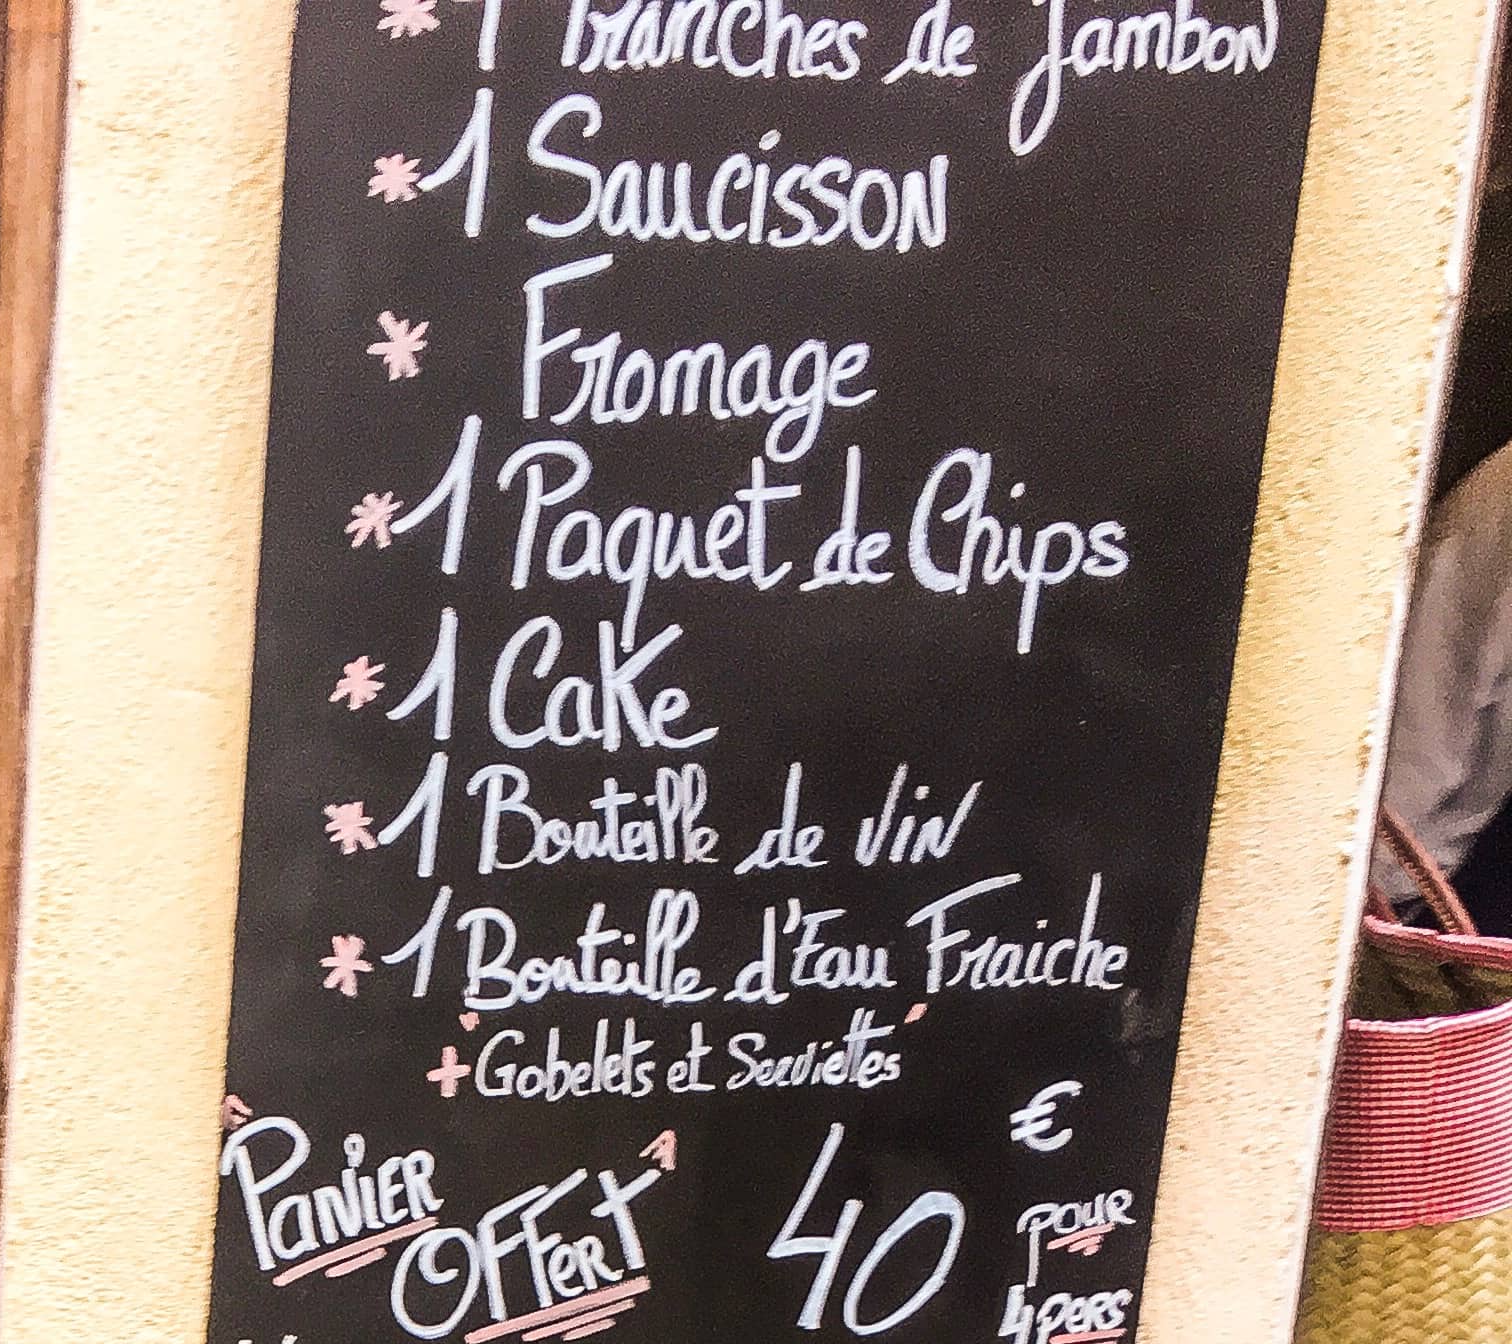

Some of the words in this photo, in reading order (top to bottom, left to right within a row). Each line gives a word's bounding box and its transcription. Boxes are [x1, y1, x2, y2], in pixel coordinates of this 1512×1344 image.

[881, 0, 977, 84] de
[421, 88, 494, 237] 1
[522, 253, 878, 464] Fromage
[391, 414, 482, 576] 1
[497, 440, 803, 653] Paquet
[800, 445, 895, 592] de
[908, 448, 1131, 655] Chips
[386, 606, 459, 741] 1
[378, 752, 449, 878] 1
[466, 763, 720, 875] Bouteille
[733, 762, 829, 875] de
[380, 886, 452, 998] 1
[456, 888, 718, 1014] Bouteille
[907, 872, 1129, 994] Fraiche
[475, 1018, 655, 1102] Gobelets
[666, 1021, 717, 1092] et
[727, 1007, 902, 1090] Serviettes
[1010, 1080, 1084, 1151] €
[766, 1123, 965, 1336] 40
